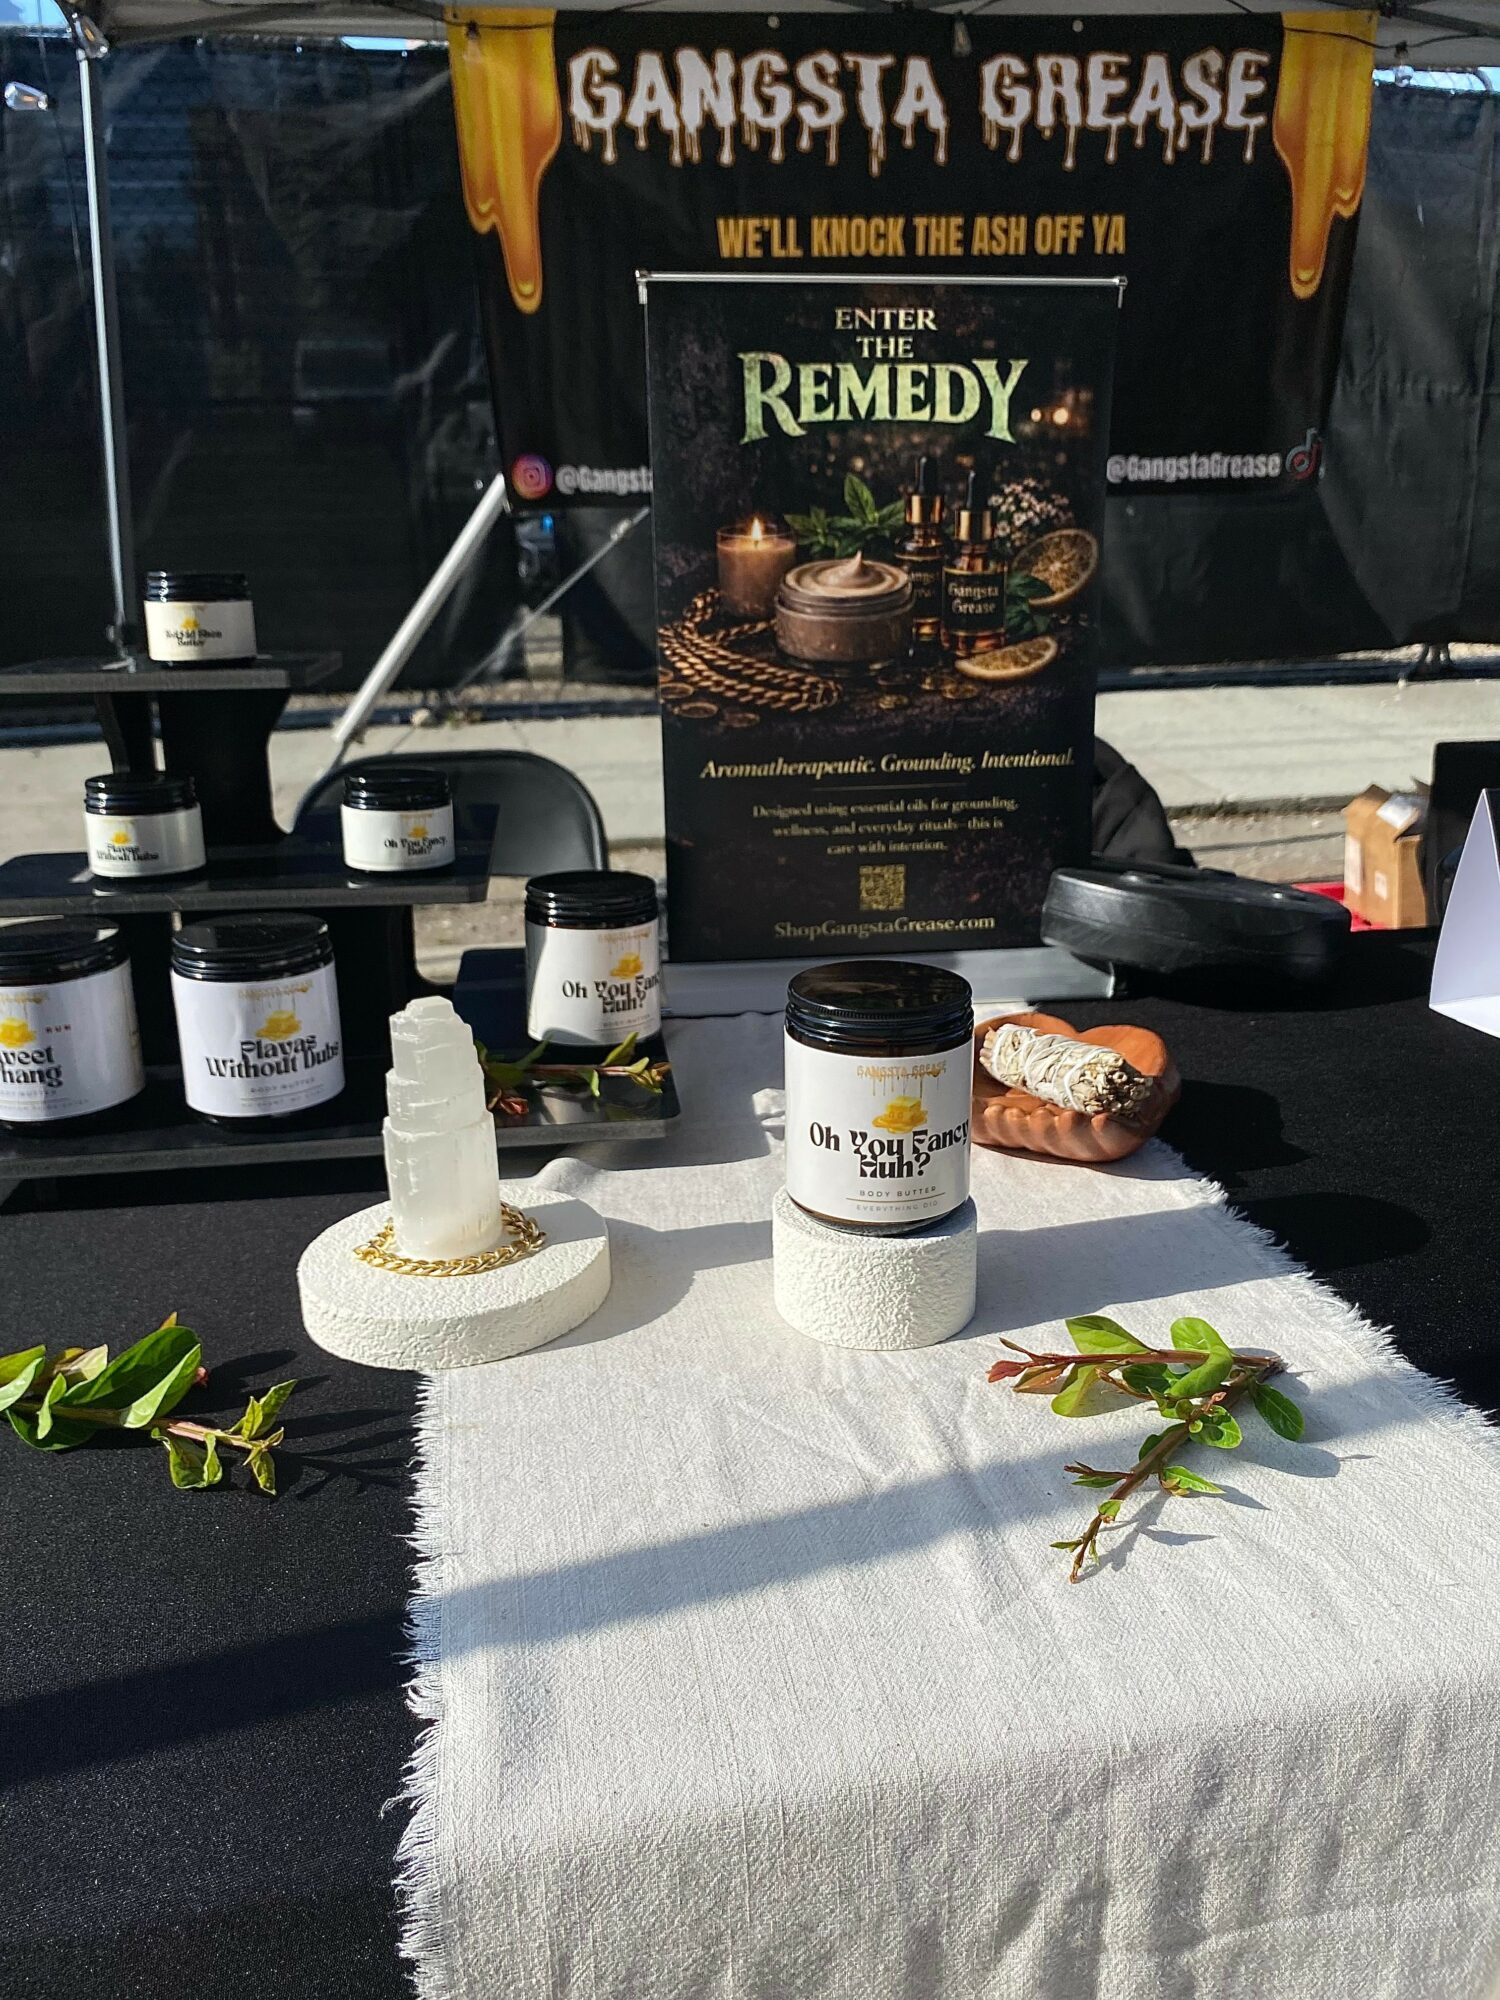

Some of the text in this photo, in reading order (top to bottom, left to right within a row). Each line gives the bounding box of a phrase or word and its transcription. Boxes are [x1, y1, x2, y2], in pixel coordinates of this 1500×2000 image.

[568, 47, 1270, 176] GANGSTA GREASE
[716, 214, 1126, 258] WE'LL KNOCK THE ASH OFF YA
[835, 307, 938, 331] ENTER
[856, 335, 914, 359] THE
[737, 351, 1029, 445] REMEDY
[1106, 452, 1281, 484] @GangstaGrease
[948, 582, 999, 600] Gangsta
[952, 598, 996, 614] Grease
[700, 747, 1075, 779] Aromatherapeutic. Grounding. Intentional.
[753, 803, 812, 819] Designed
[815, 803, 848, 817] using
[850, 800, 905, 814] essential
[907, 799, 929, 811] oils
[931, 797, 949, 811] for
[773, 823, 830, 838] wellness,
[832, 821, 856, 835] and
[858, 819, 916, 835] everyday
[993, 815, 1004, 830] is
[827, 838, 948, 855] care with intention.
[774, 914, 996, 940] ShopGangstaGrease.com
[562, 973, 660, 1001] Oh You Fan
[602, 990, 648, 1014] Huh?
[0, 1046, 55, 1065] weet
[240, 1035, 317, 1060] Playas
[0, 1063, 63, 1088] hang
[205, 1055, 298, 1078] Without
[856, 1065, 908, 1080] GANGSTA
[810, 1118, 969, 1159] Oh You Fancy
[860, 1151, 931, 1179] Huh?
[897, 1185, 937, 1197] BUTTER
[856, 1204, 919, 1212] EVERYTHING
